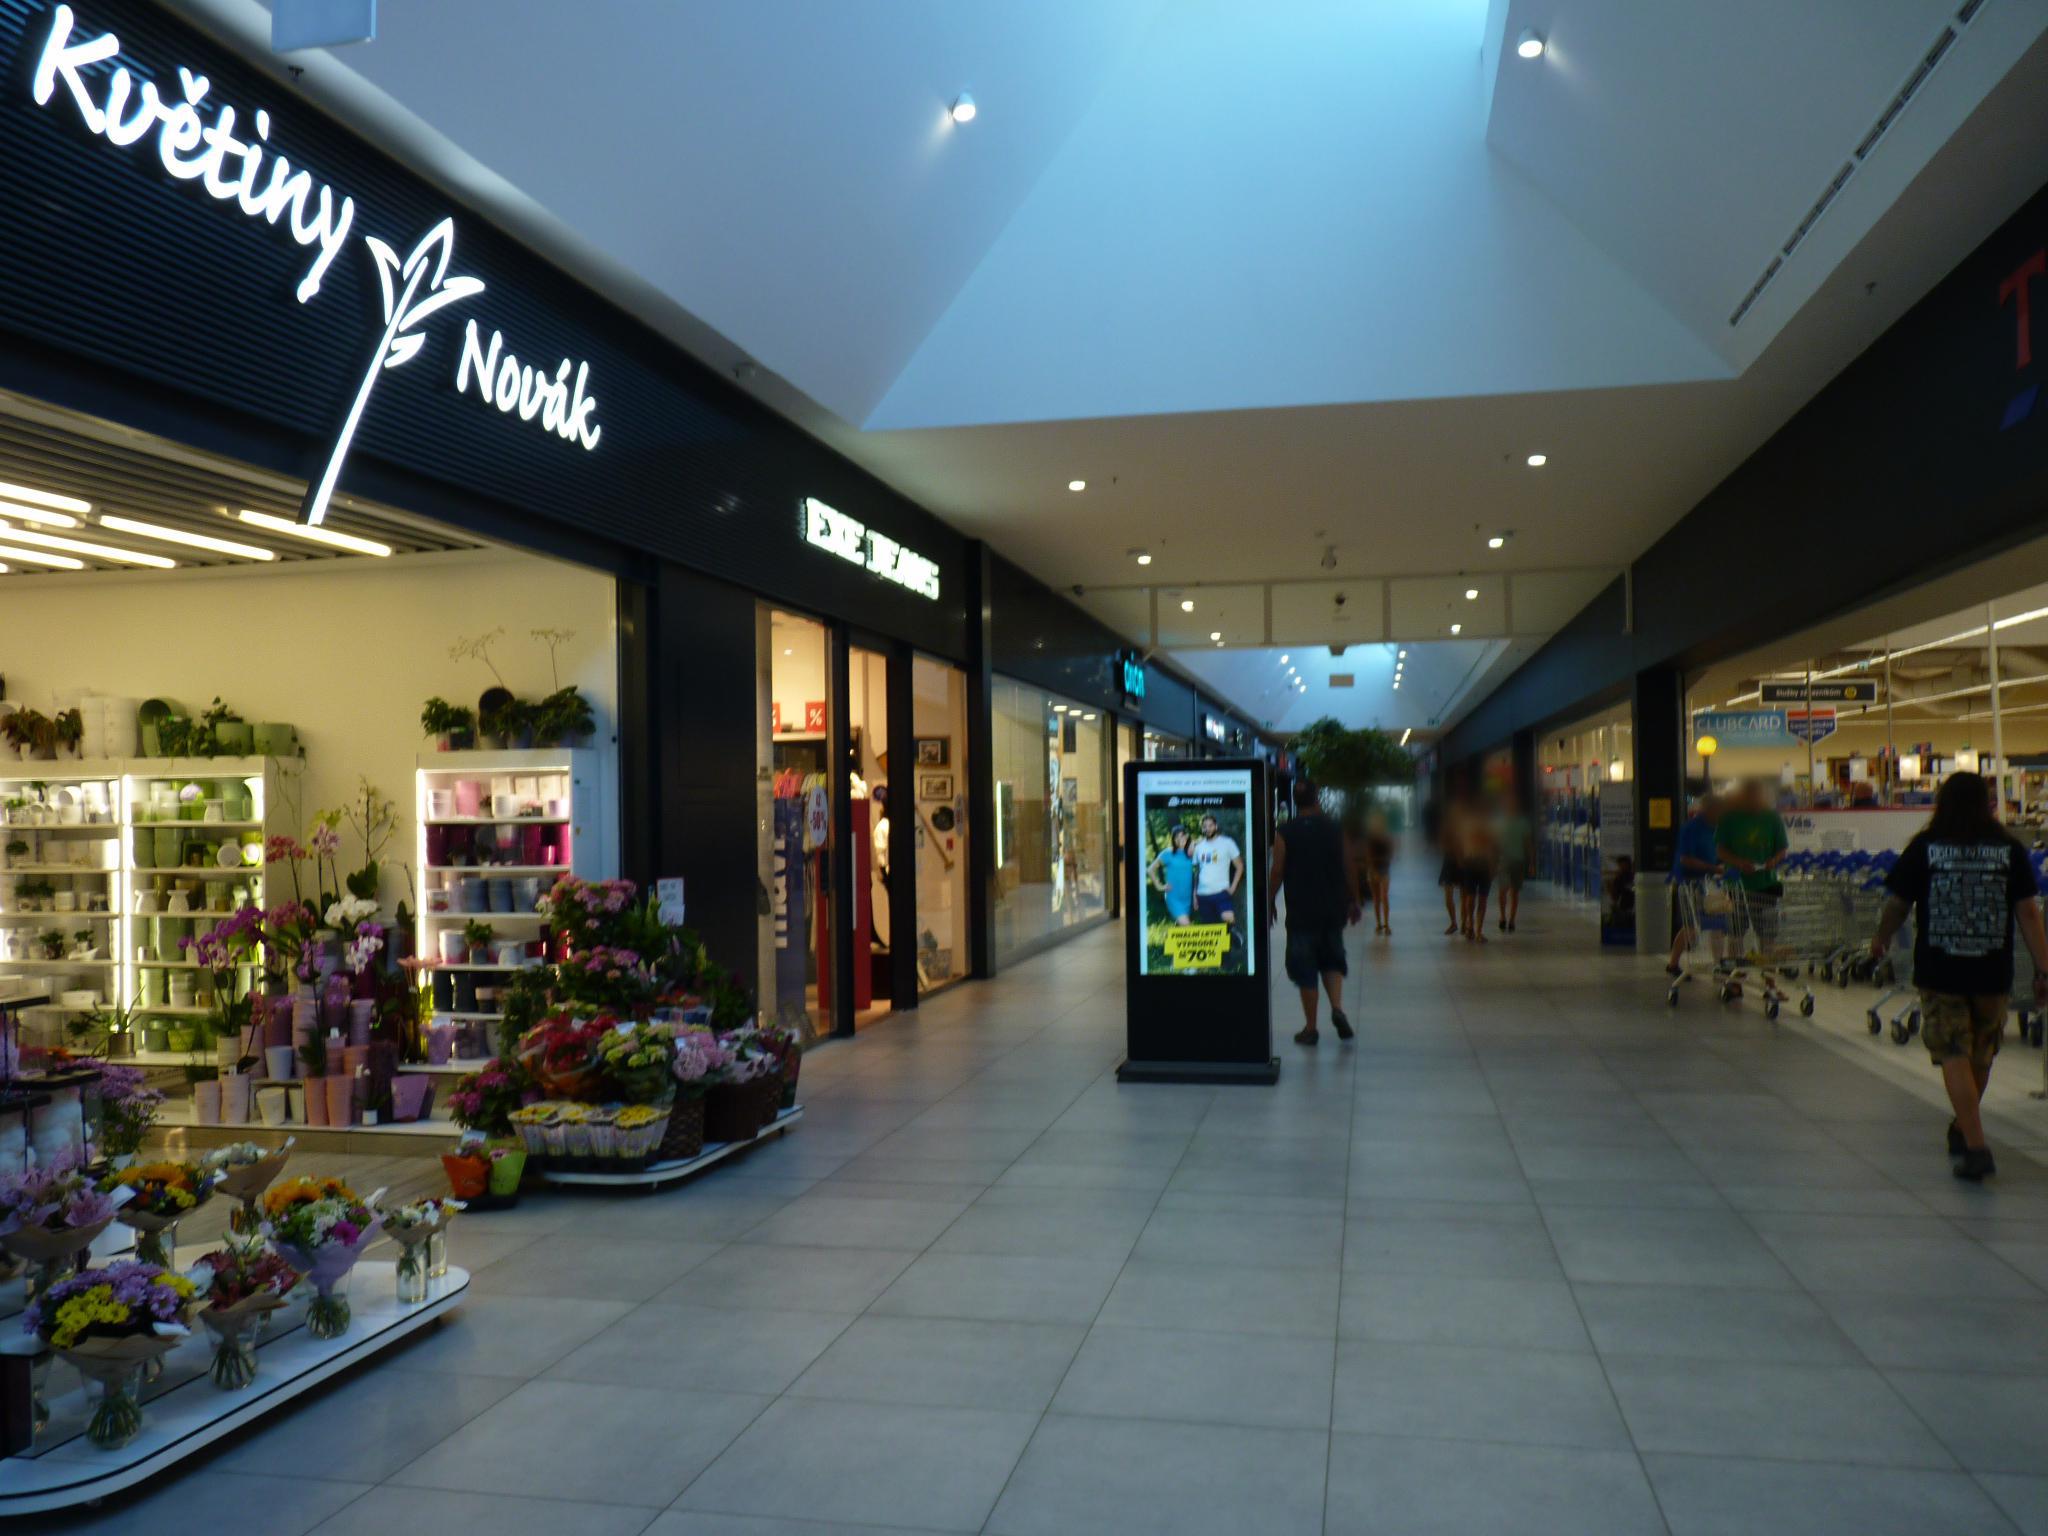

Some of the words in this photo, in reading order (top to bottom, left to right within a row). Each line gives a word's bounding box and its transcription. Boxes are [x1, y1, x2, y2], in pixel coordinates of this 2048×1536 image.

[33, 4, 354, 303] Květiny
[457, 318, 600, 450] Novák
[806, 496, 865, 566] EXE
[1696, 714, 1782, 732] CLUBCARD
